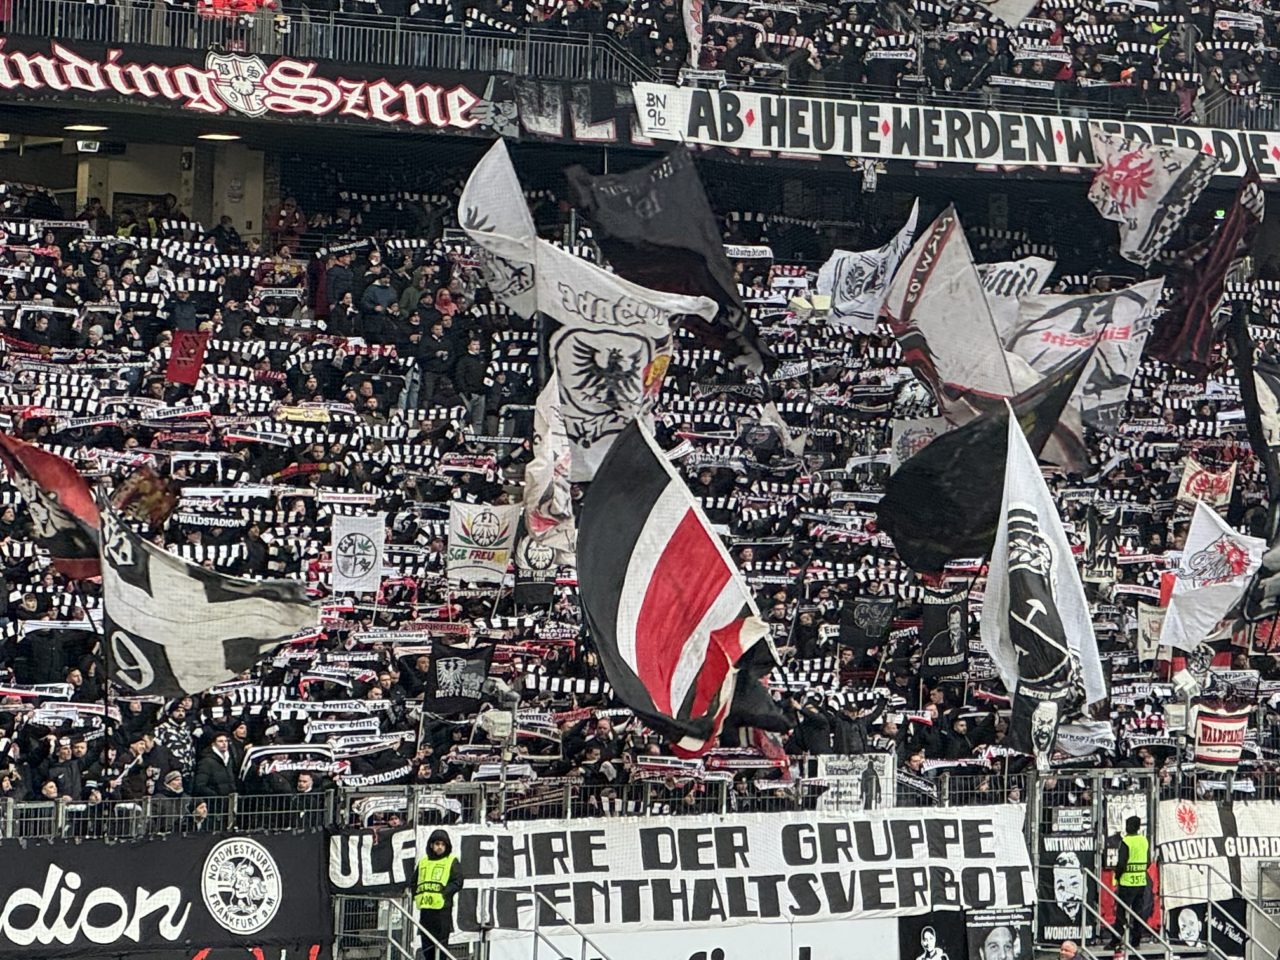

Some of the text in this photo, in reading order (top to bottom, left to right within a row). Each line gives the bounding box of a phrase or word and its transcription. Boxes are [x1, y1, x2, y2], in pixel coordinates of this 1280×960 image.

[645, 91, 667, 109] BN
[648, 108, 667, 129] 96
[687, 90, 746, 145] AB
[761, 96, 883, 152] HEUTE
[892, 106, 1056, 164] WERDEN
[1210, 132, 1275, 176] DIE
[69, 415, 114, 427] Eintracht
[157, 404, 204, 417] Eintracht
[461, 818, 996, 880] EHRE DER GRUPPE
[1044, 836, 1093, 852] WITTKOWSKI
[1162, 839, 1218, 862] NUOVA
[208, 844, 275, 881] NORDWESTKURVE
[209, 890, 260, 929] FRANKFURT
